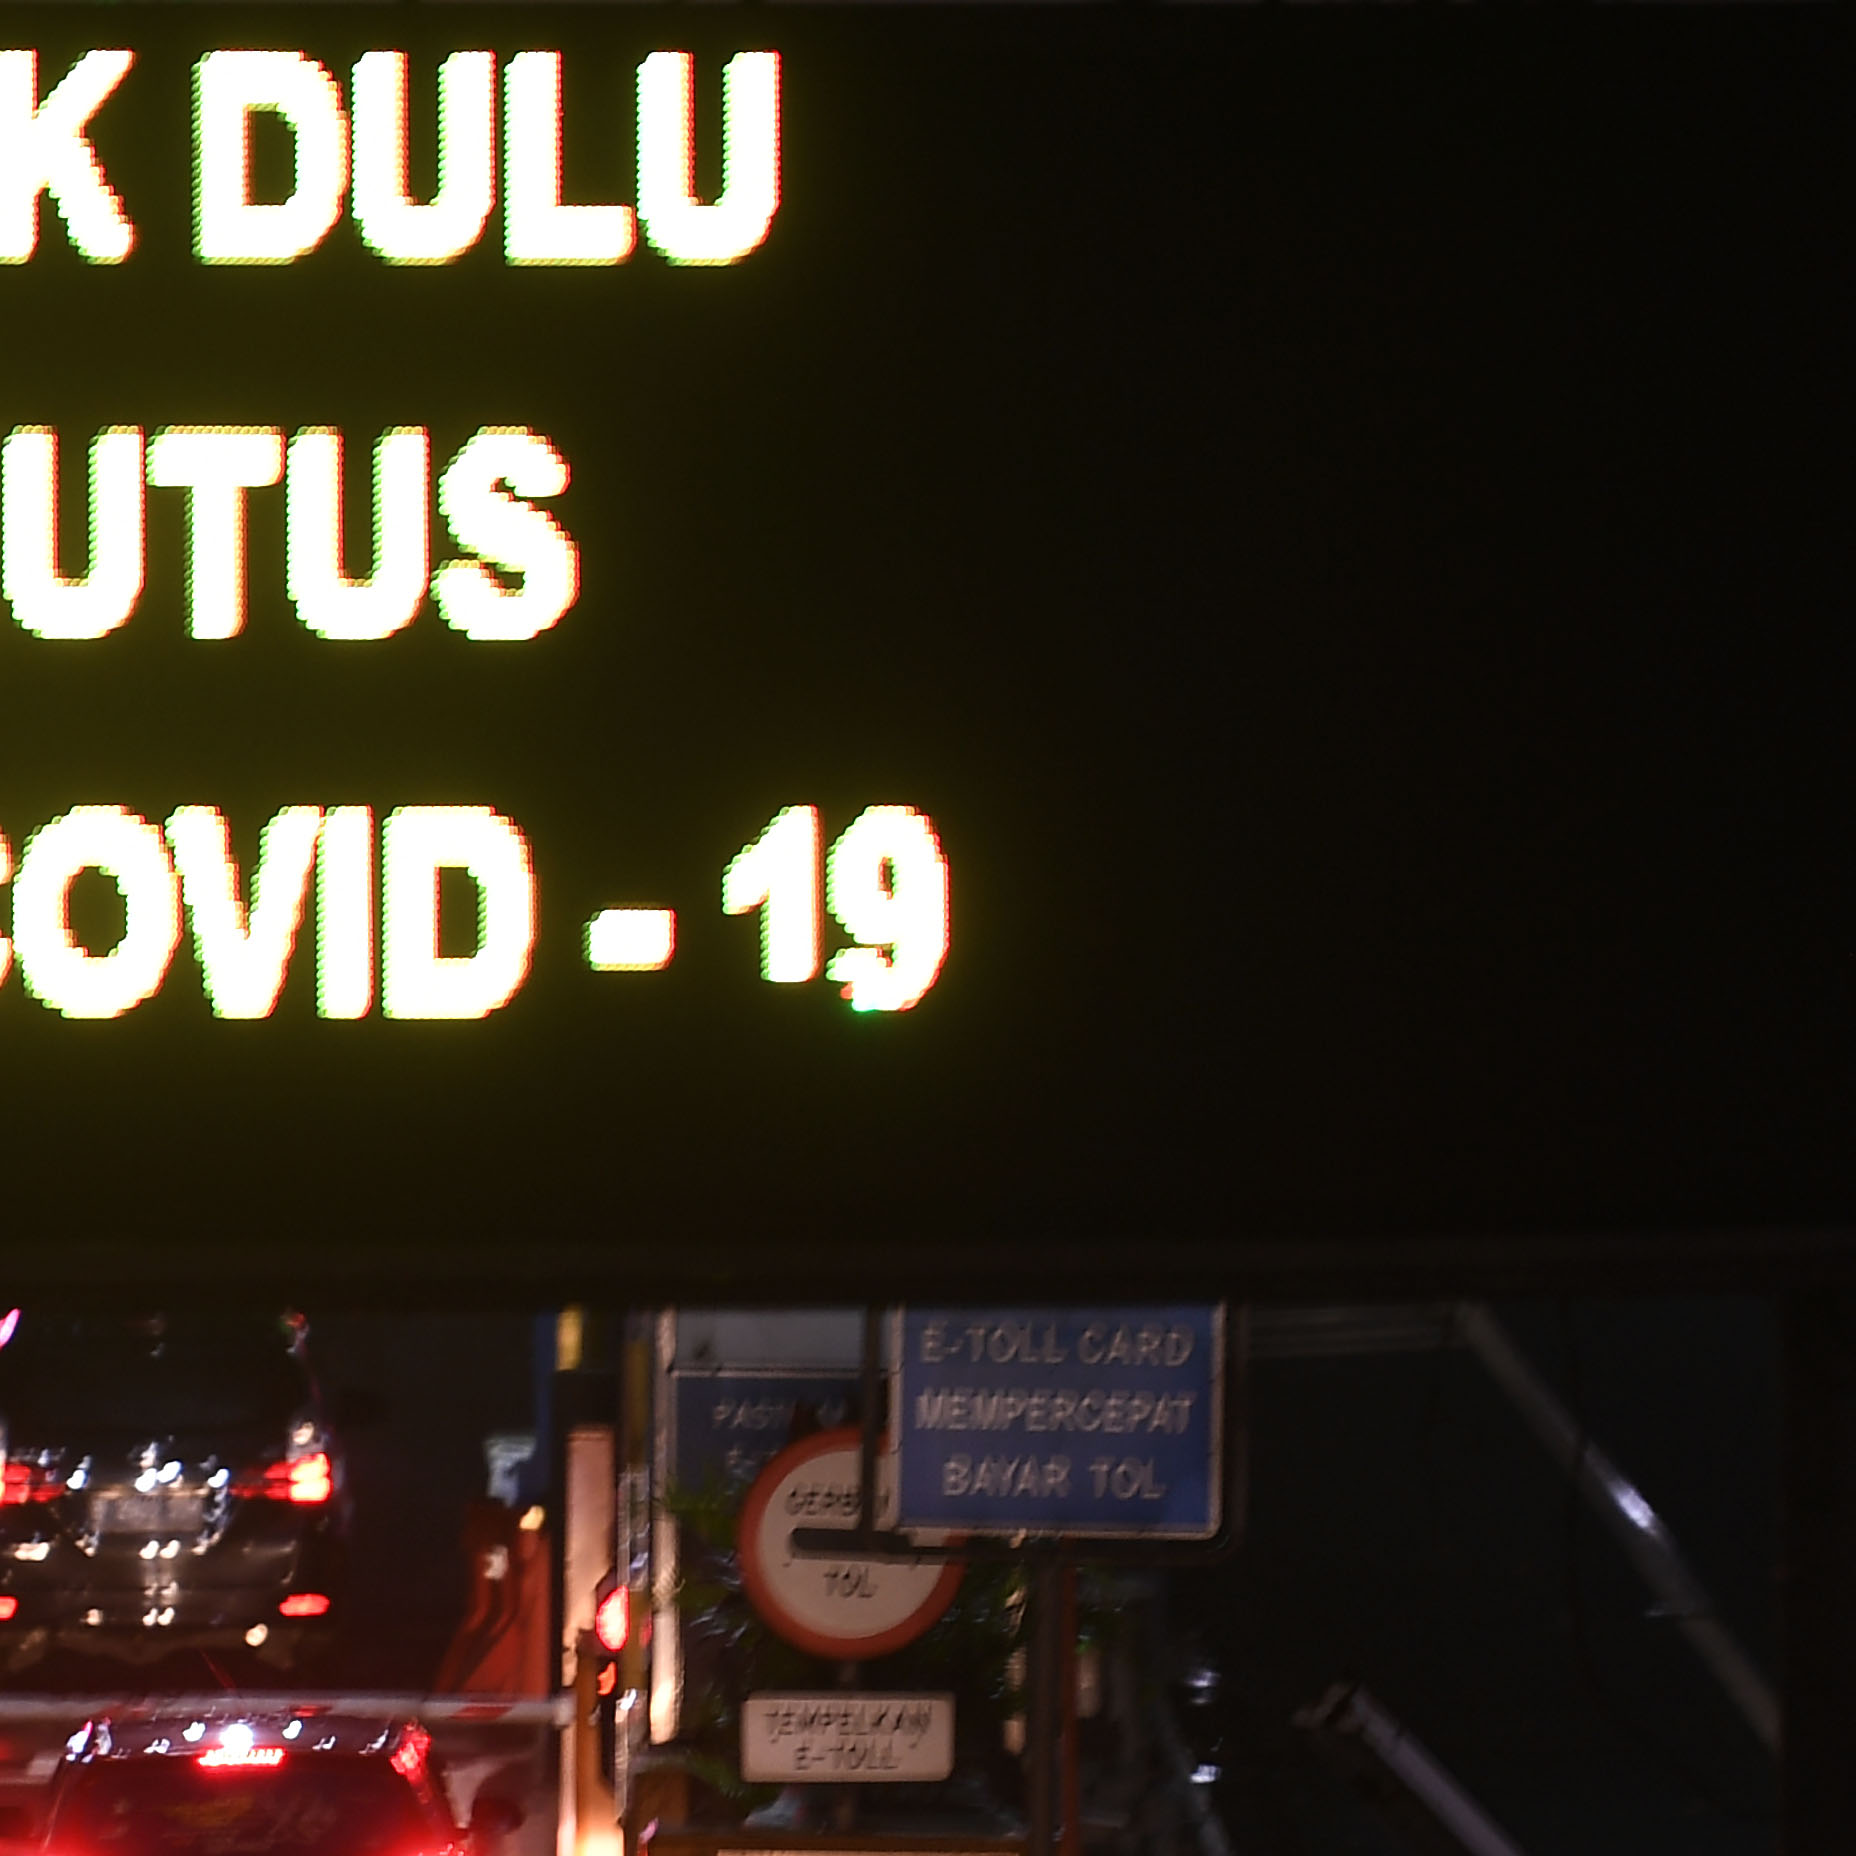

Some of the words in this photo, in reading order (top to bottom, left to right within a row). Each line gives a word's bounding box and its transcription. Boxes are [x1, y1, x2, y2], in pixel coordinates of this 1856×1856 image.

[192, 50, 782, 266] DULU
[722, 805, 951, 1013] 19
[920, 1321, 1071, 1364] E-TOLL
[1077, 1323, 1196, 1368] CARD
[914, 1387, 1196, 1434] MEMPERCEPAT
[943, 1454, 1073, 1498] BAYAR
[1089, 1456, 1169, 1500] TOL
[824, 1567, 877, 1598] TOL
[795, 1742, 899, 1771] E-TOLL
